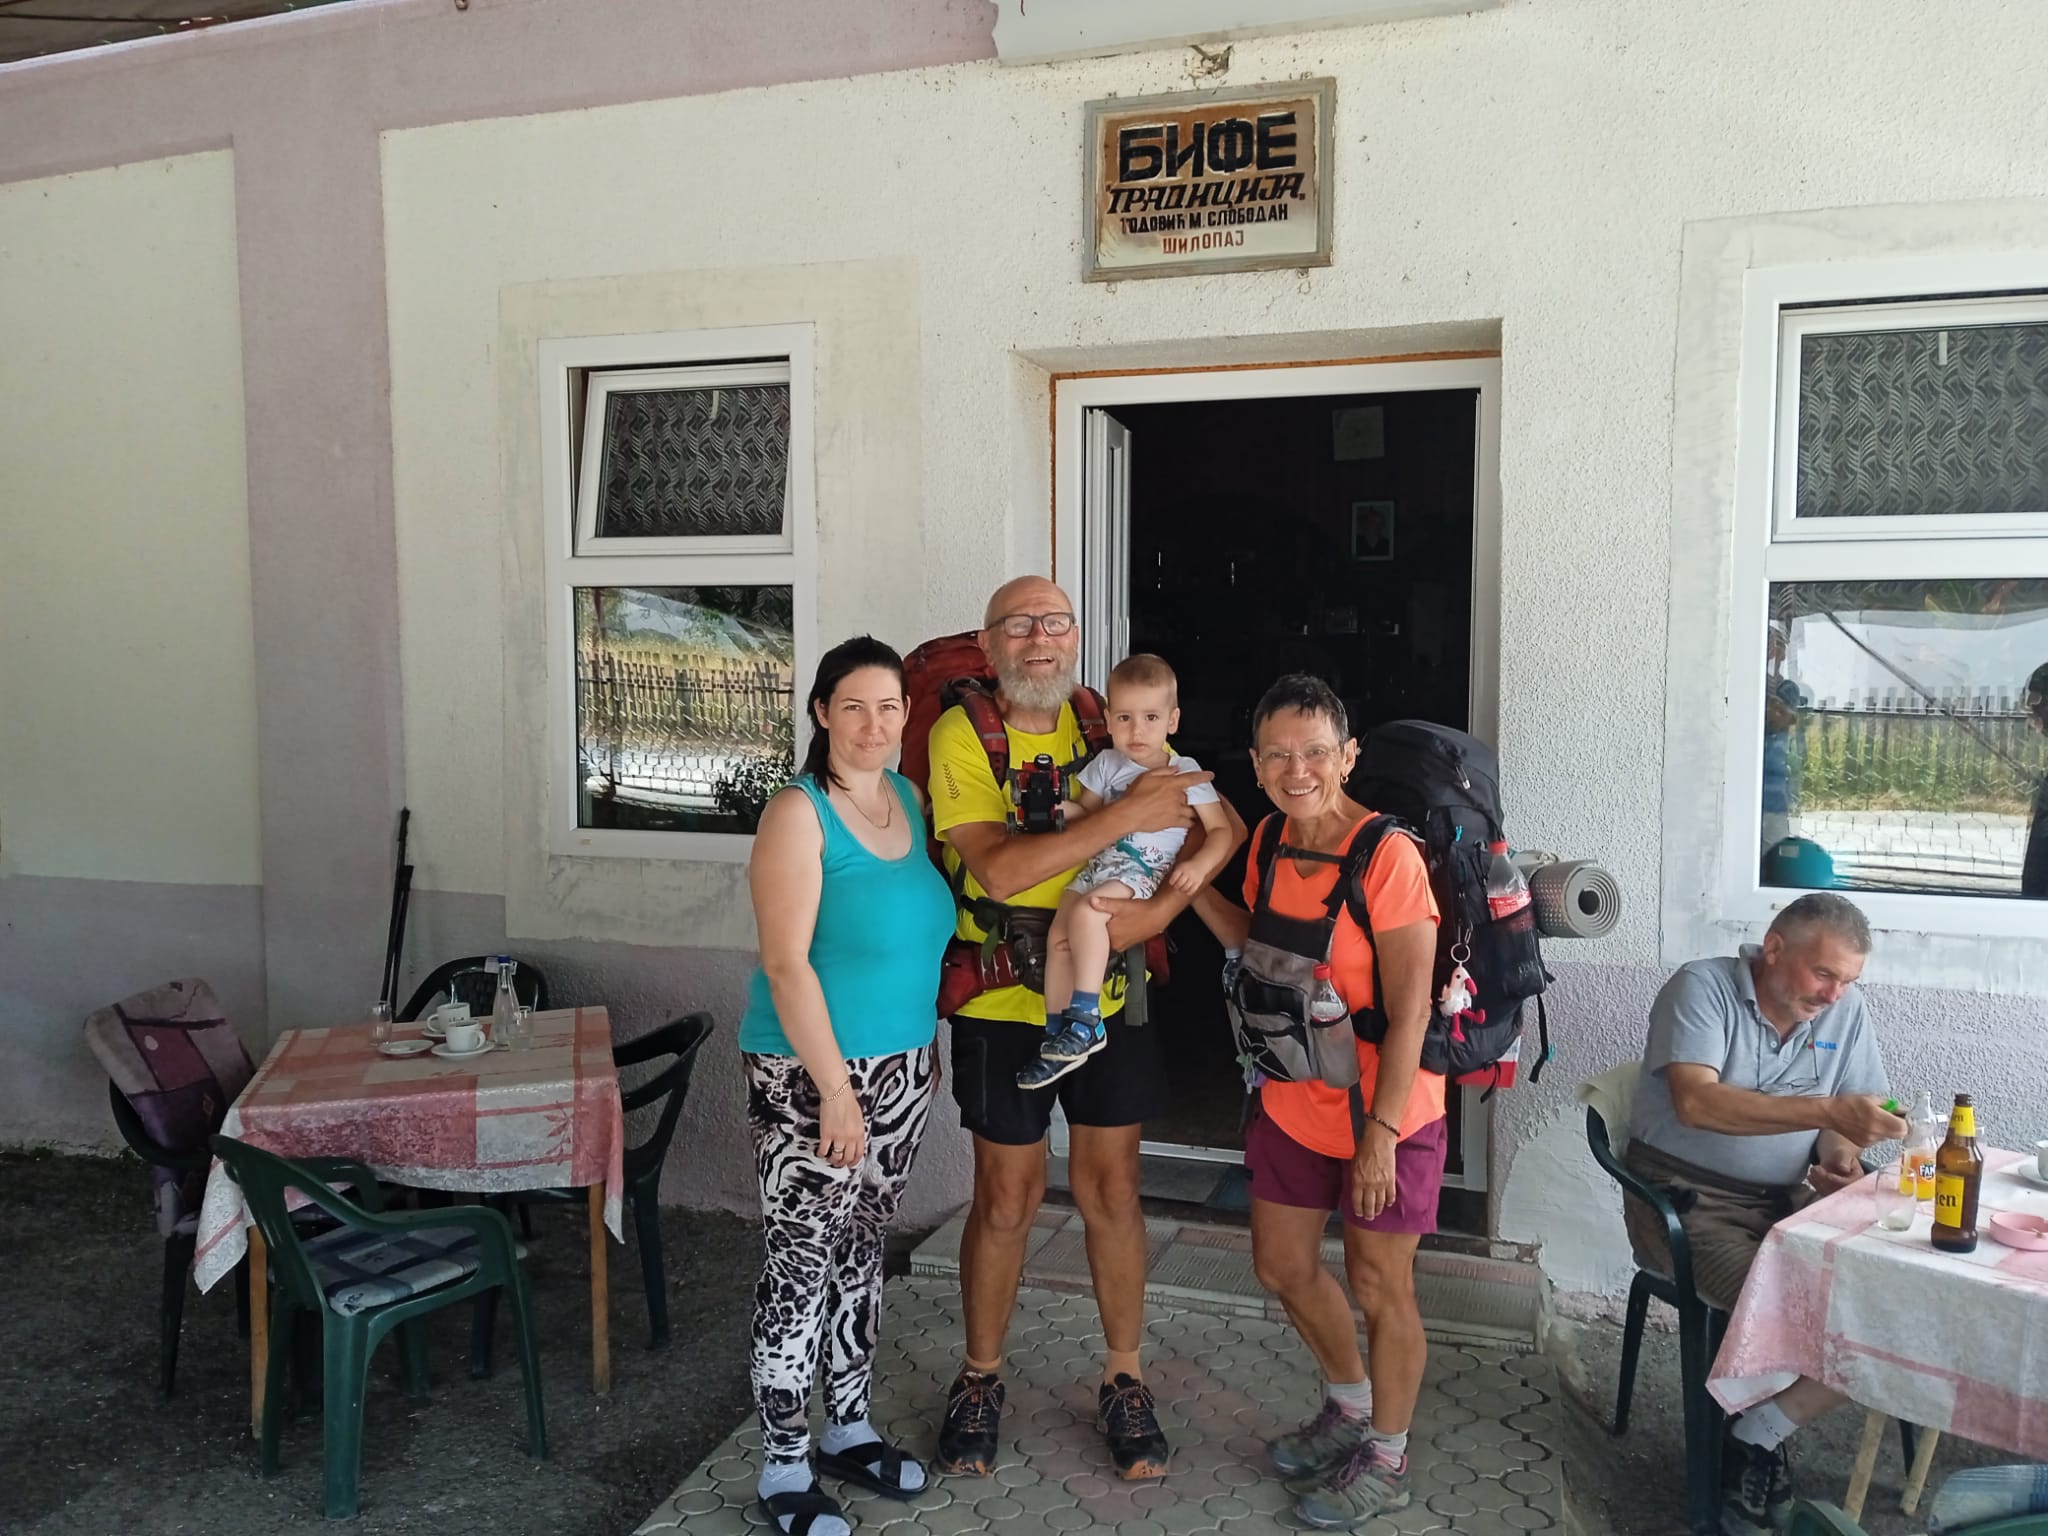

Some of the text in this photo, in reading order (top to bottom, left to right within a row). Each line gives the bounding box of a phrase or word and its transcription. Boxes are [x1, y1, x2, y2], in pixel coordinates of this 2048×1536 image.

[1119, 111, 1297, 183] БИФЕ
[1208, 203, 1288, 226] СЛОБОДАН
[1163, 230, 1244, 254] ШИЛОПАЈ
